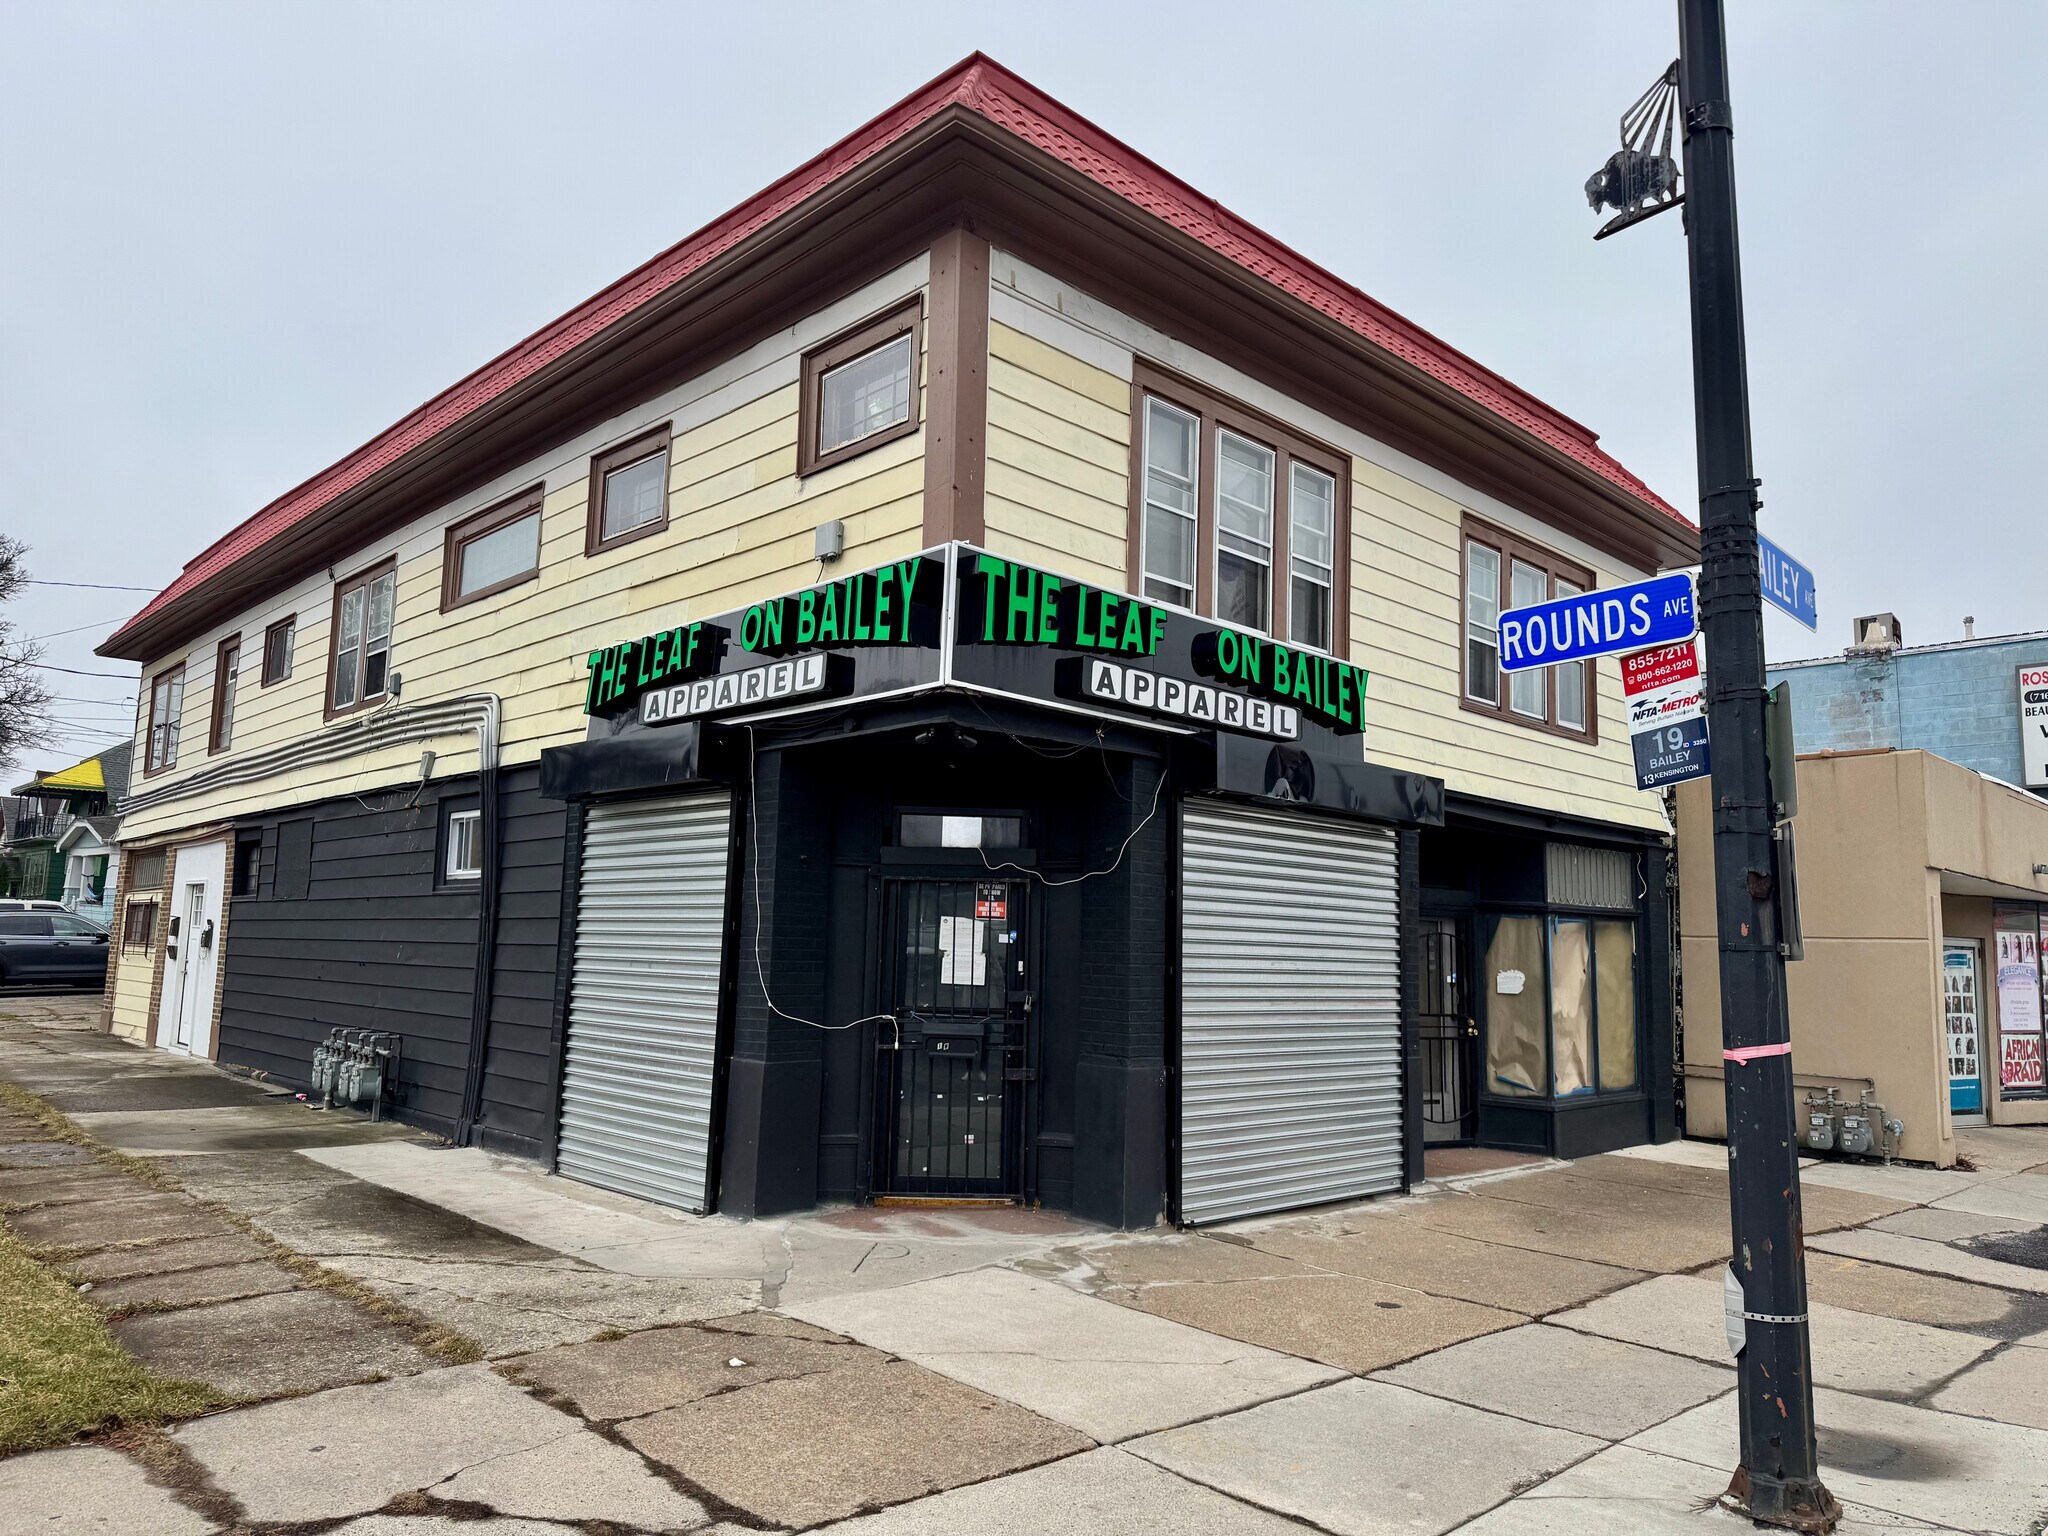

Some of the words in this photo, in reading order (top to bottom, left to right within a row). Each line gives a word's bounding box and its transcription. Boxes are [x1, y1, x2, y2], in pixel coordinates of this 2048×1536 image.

[583, 642, 631, 714] THE
[637, 621, 701, 687] LEAF
[740, 600, 785, 652] ON
[796, 557, 924, 644] BAILEY
[1502, 593, 1651, 661] ROUNDS
[1663, 597, 1690, 617] AVE
[978, 554, 1061, 643] THE
[1076, 585, 1167, 656] LEAF
[1218, 629, 1261, 684] ON
[1274, 644, 1370, 733] BAILEY
[1628, 643, 1688, 671] 855-7211
[1636, 659, 1693, 682] 800-662-1220
[1641, 674, 1681, 690] nfta.com
[648, 659, 817, 720] APPAREL
[1094, 665, 1295, 735] APPAREL
[1638, 718, 1656, 727] Serving
[1657, 713, 1674, 722] Buffalo
[1652, 727, 1684, 753] 19
[1650, 750, 1691, 769] BAILEY
[1643, 774, 1655, 785] 13
[1654, 763, 1699, 780] KENSINGTON
[2004, 965, 2032, 977] ELEGANCE
